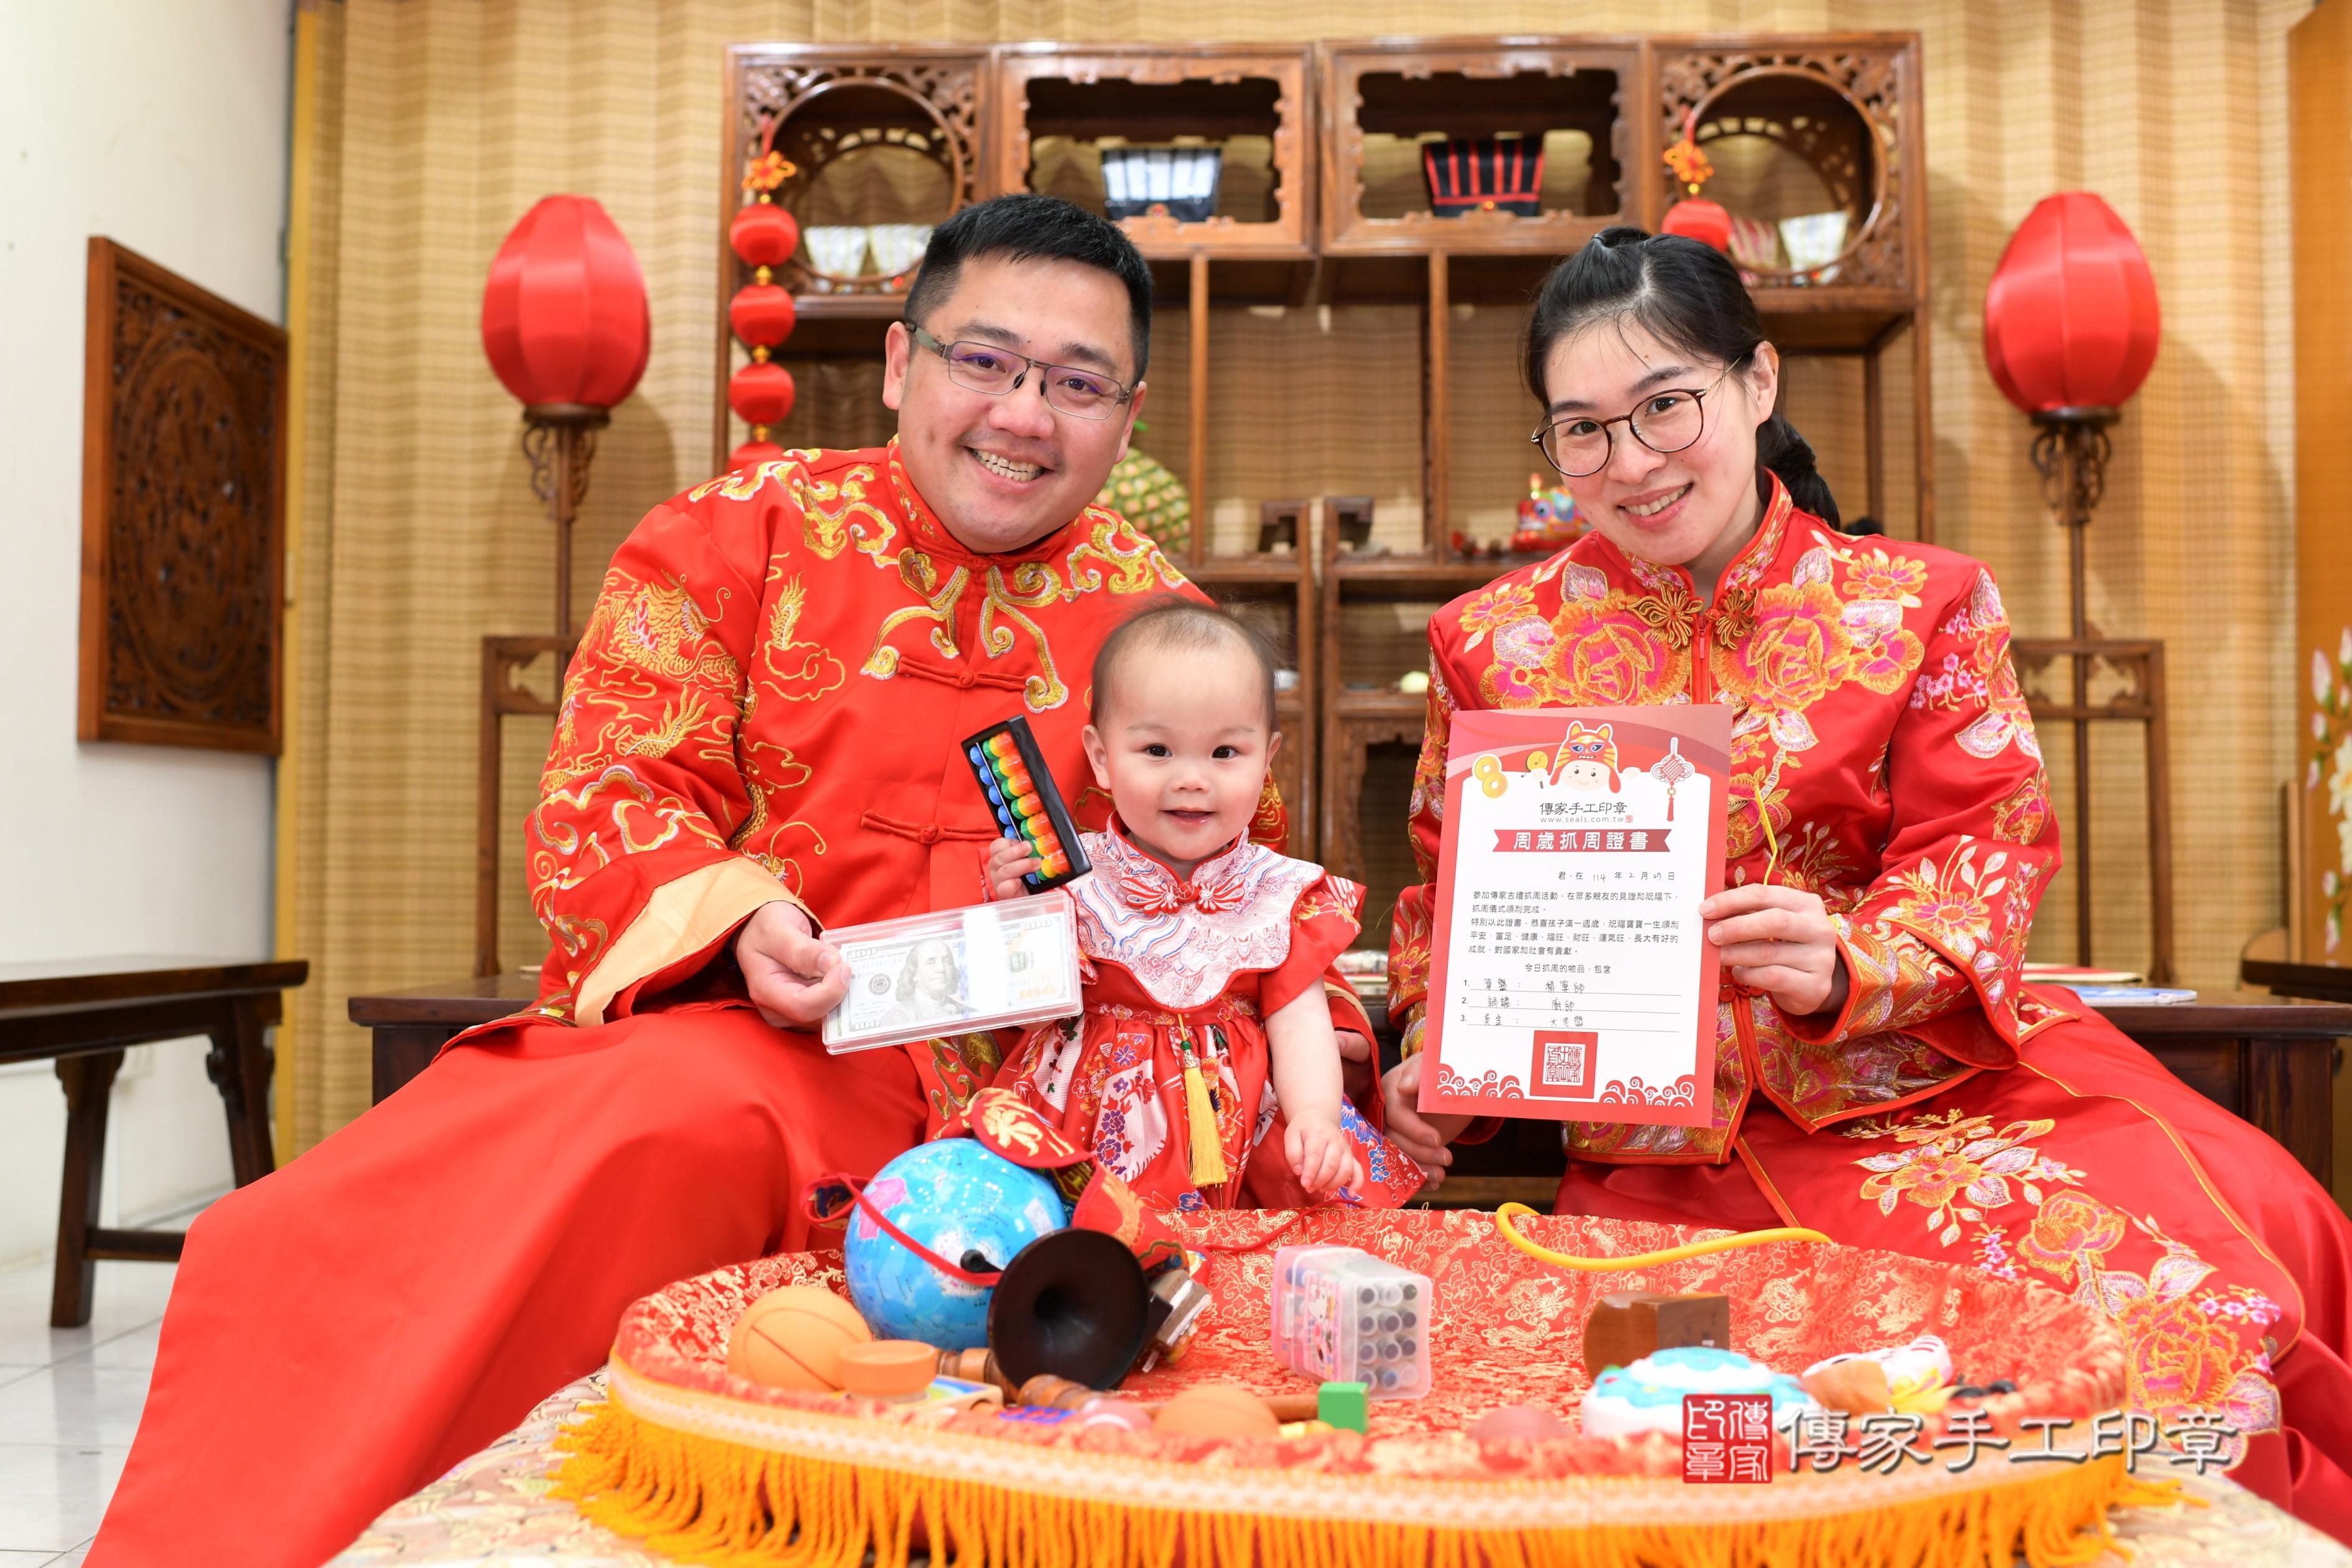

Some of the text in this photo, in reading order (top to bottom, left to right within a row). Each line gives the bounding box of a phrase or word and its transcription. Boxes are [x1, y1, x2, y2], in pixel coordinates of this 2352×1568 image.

[1539, 801, 1628, 815] 傳家手工印章
[1513, 831, 1648, 851] 周歲抓周證書
[1593, 874, 1607, 883] 114
[1614, 872, 1622, 881] 年
[1640, 871, 1648, 881] 月
[1668, 871, 1675, 881] 日
